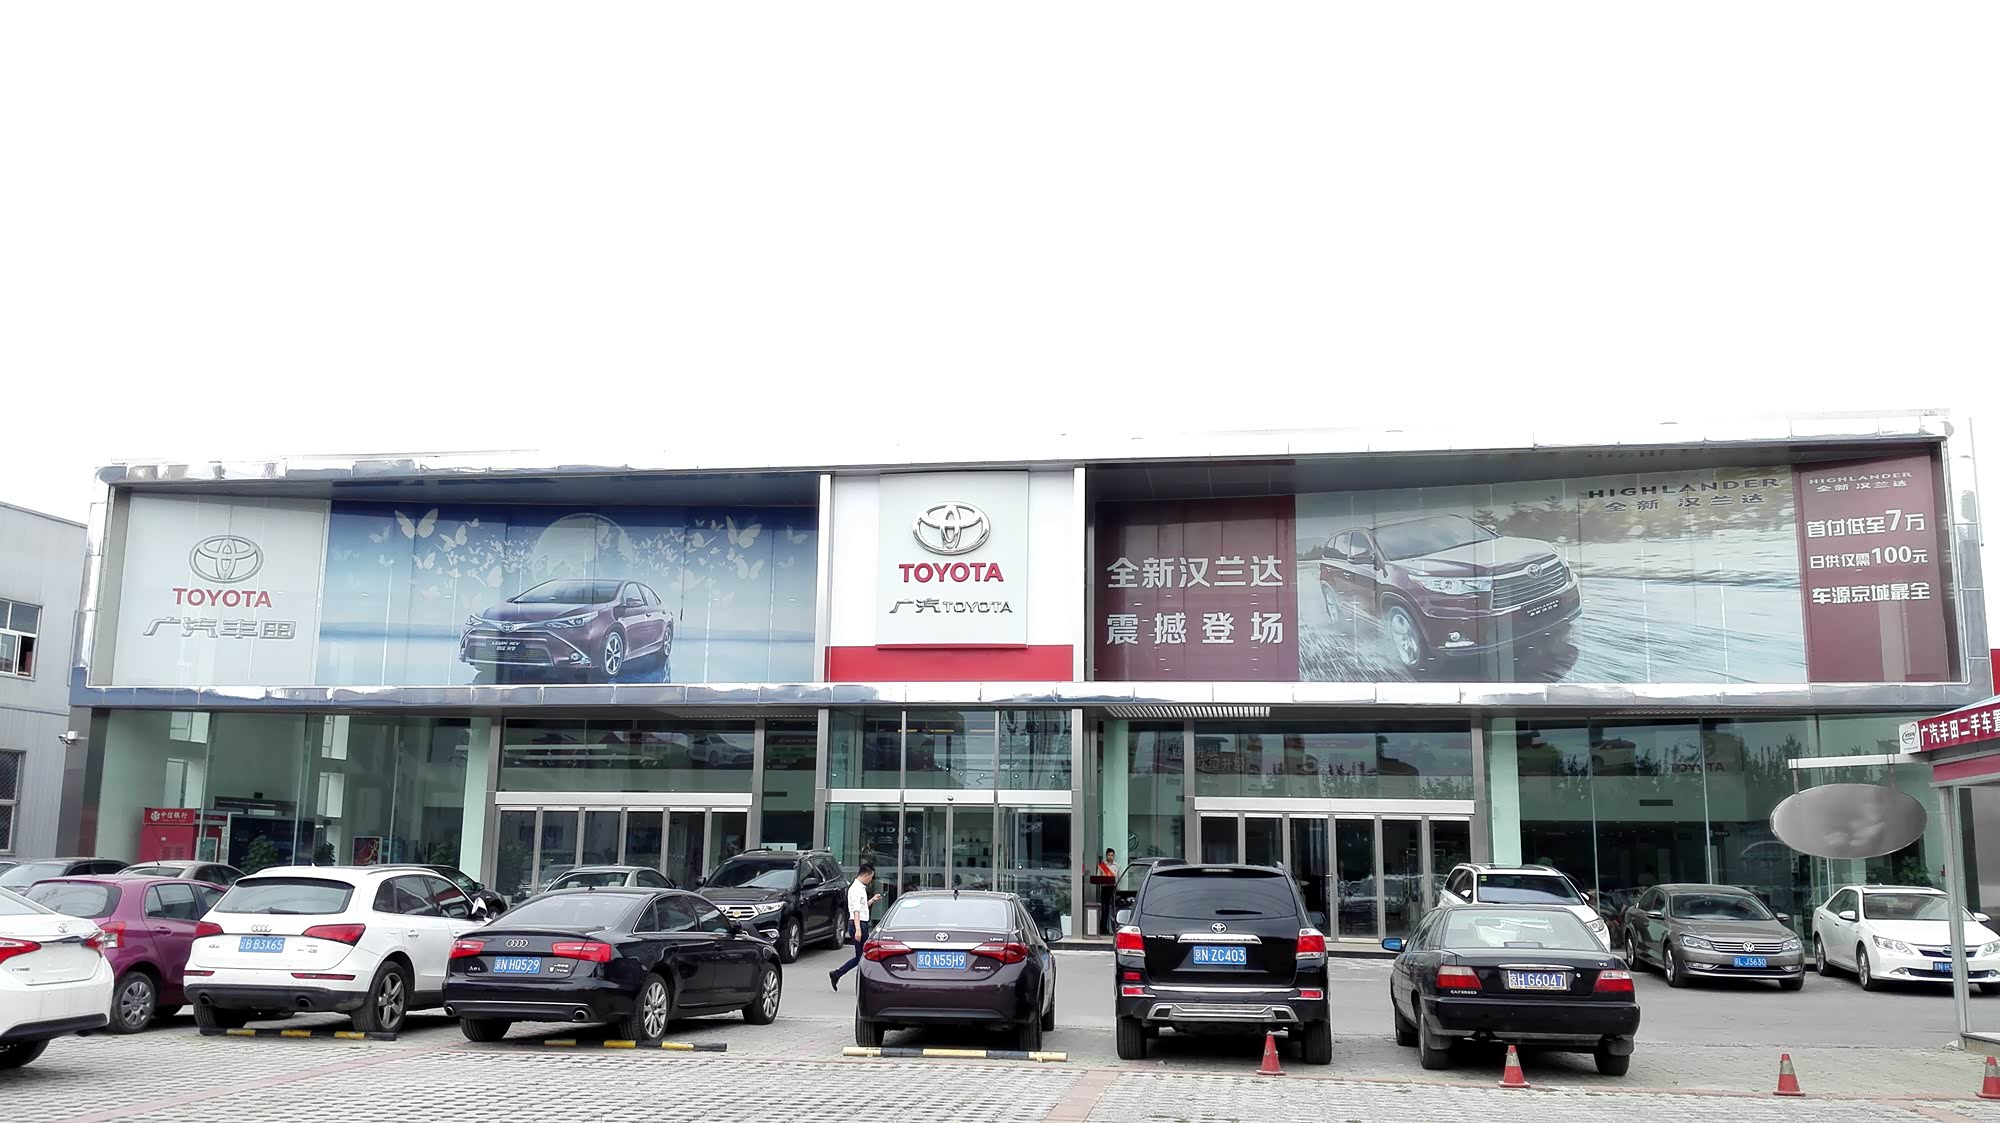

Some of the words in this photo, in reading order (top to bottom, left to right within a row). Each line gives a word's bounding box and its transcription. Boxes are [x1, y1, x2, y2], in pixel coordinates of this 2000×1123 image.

[1588, 478, 1780, 499] HIGHLANDER
[1809, 472, 1912, 484] HIGHLANDER
[1605, 499, 1660, 512] 全新
[1677, 493, 1764, 508] 汉兰达
[1807, 509, 1925, 537] 首付低至7万
[1809, 546, 1929, 570] 日供仅需100元
[898, 562, 1004, 583] TOYOTA
[1107, 555, 1283, 589] 全新汉兰达
[172, 588, 272, 607] TOYOTA
[1811, 582, 1931, 605] 车源京城最全
[143, 616, 296, 640] 广汽丰田
[1107, 612, 1283, 645] 震撼登场
[161, 811, 188, 820] 中信银行
